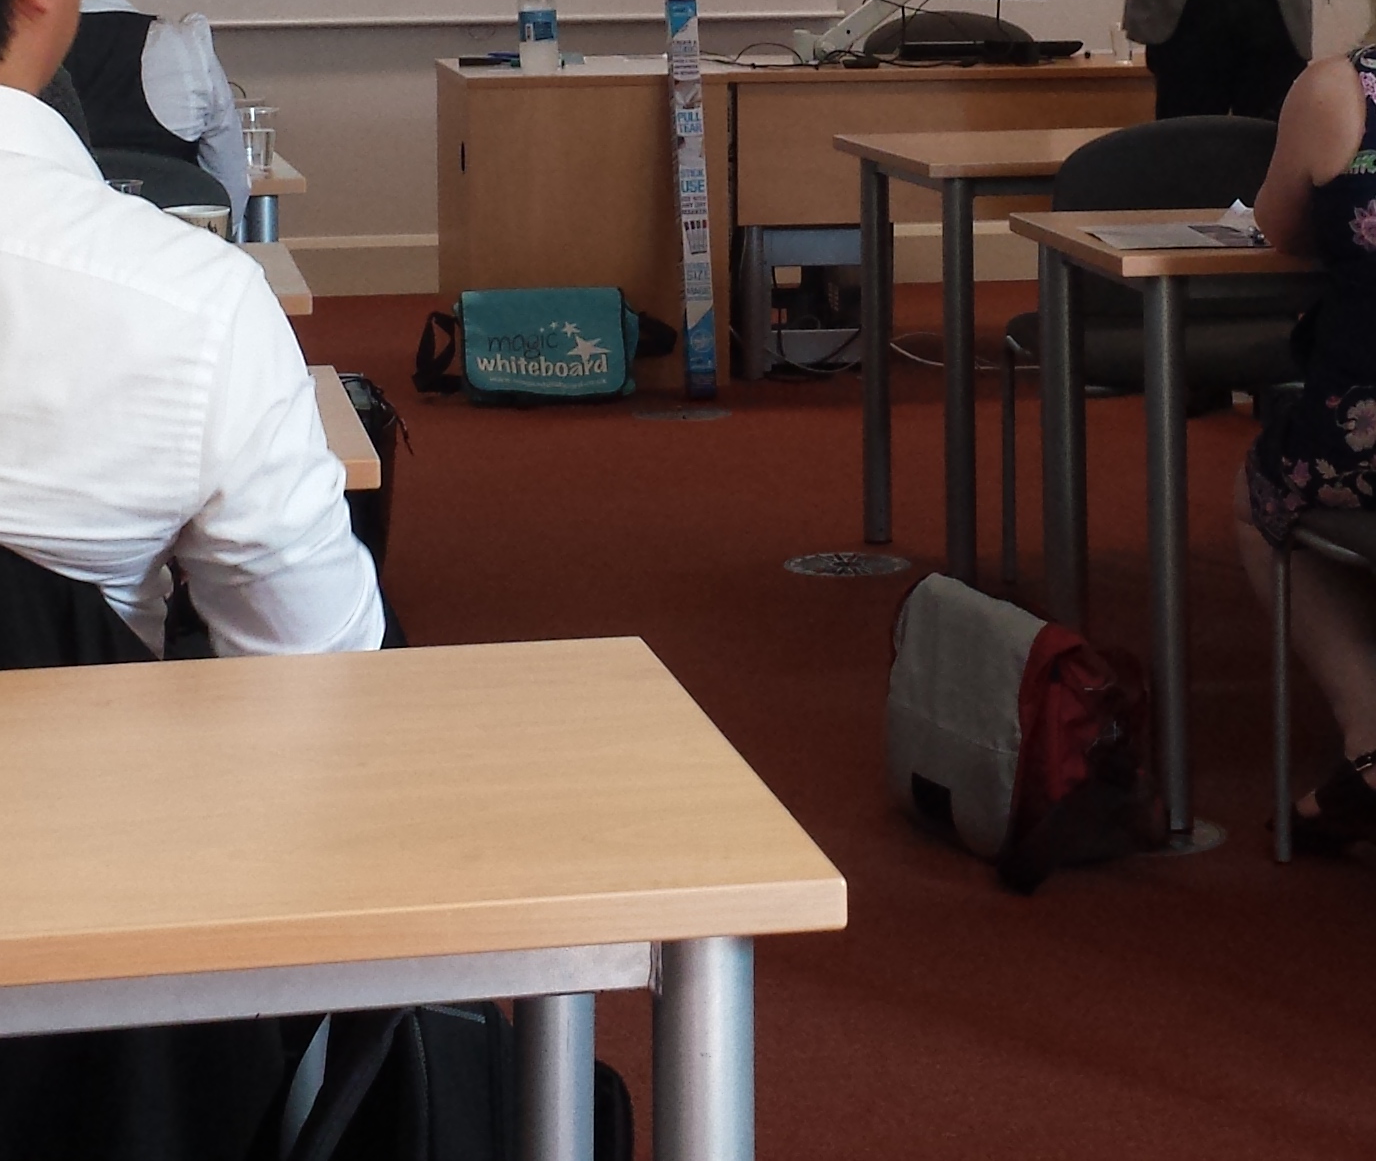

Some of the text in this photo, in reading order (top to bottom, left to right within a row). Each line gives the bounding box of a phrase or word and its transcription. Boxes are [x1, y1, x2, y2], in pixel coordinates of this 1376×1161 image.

[677, 112, 700, 122] PULL
[679, 123, 703, 133] TEAR
[681, 180, 705, 193] USE
[488, 331, 559, 359] magic
[476, 353, 608, 377] whiteboard
